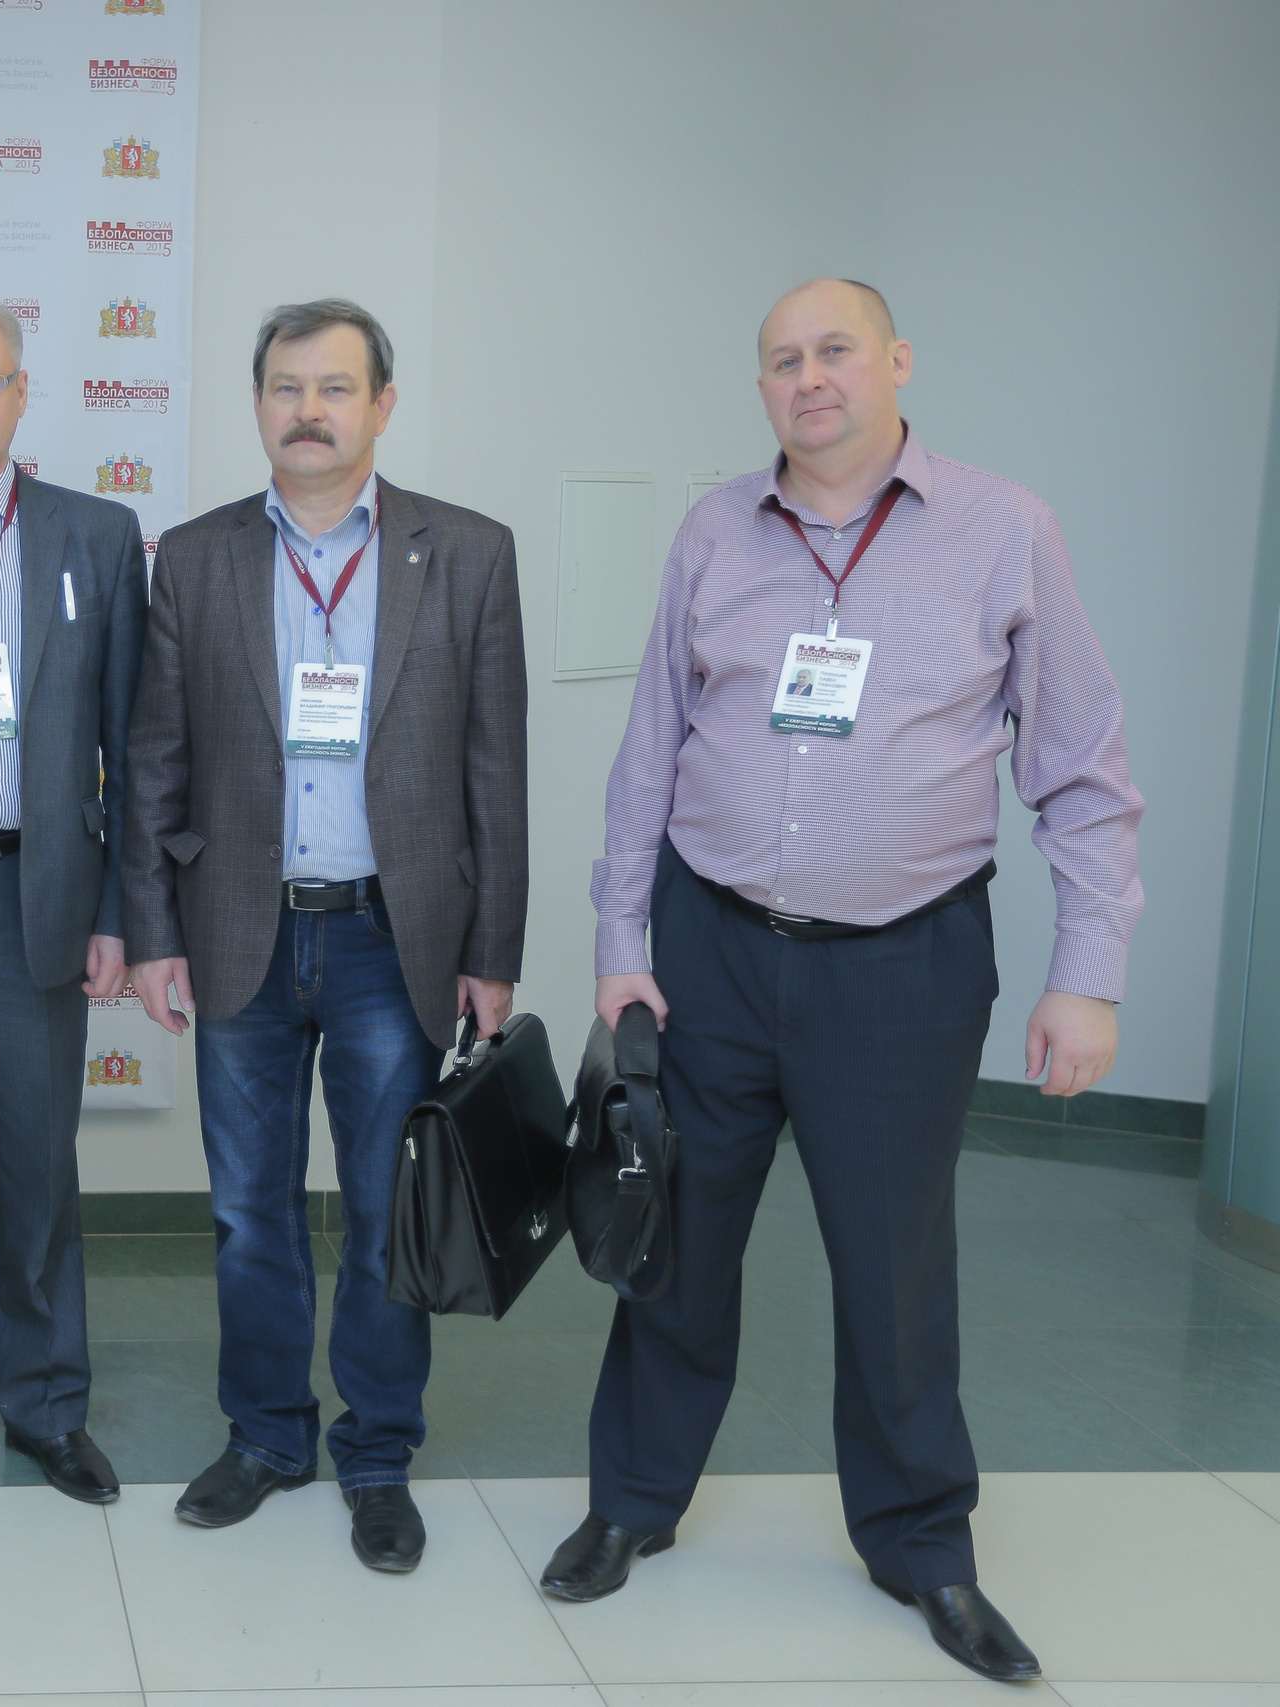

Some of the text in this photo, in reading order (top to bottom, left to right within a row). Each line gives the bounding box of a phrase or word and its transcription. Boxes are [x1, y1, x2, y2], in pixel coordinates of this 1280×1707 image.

[92, 68, 176, 78] БЕЗОПАСНОСТЬ
[92, 79, 139, 88] БИЗНЕСА
[151, 80, 176, 95] 2015
[5, 138, 40, 146] ФОРУМ
[15, 160, 40, 174] 2015
[137, 221, 171, 229] ФОРУМ
[89, 229, 171, 241] БЕЗОПАСНОСТЬ
[89, 241, 136, 251] БИЗНЕСА
[147, 242, 171, 258] 2015
[86, 388, 167, 398] БЕЗОПАСНОСТЬ
[86, 399, 132, 408] БИЗНЕСА
[143, 400, 167, 414] 2015
[798, 649, 859, 660] БЕЗОПАСНОСТЬ
[89, 999, 120, 1007] ЗНЕСА
